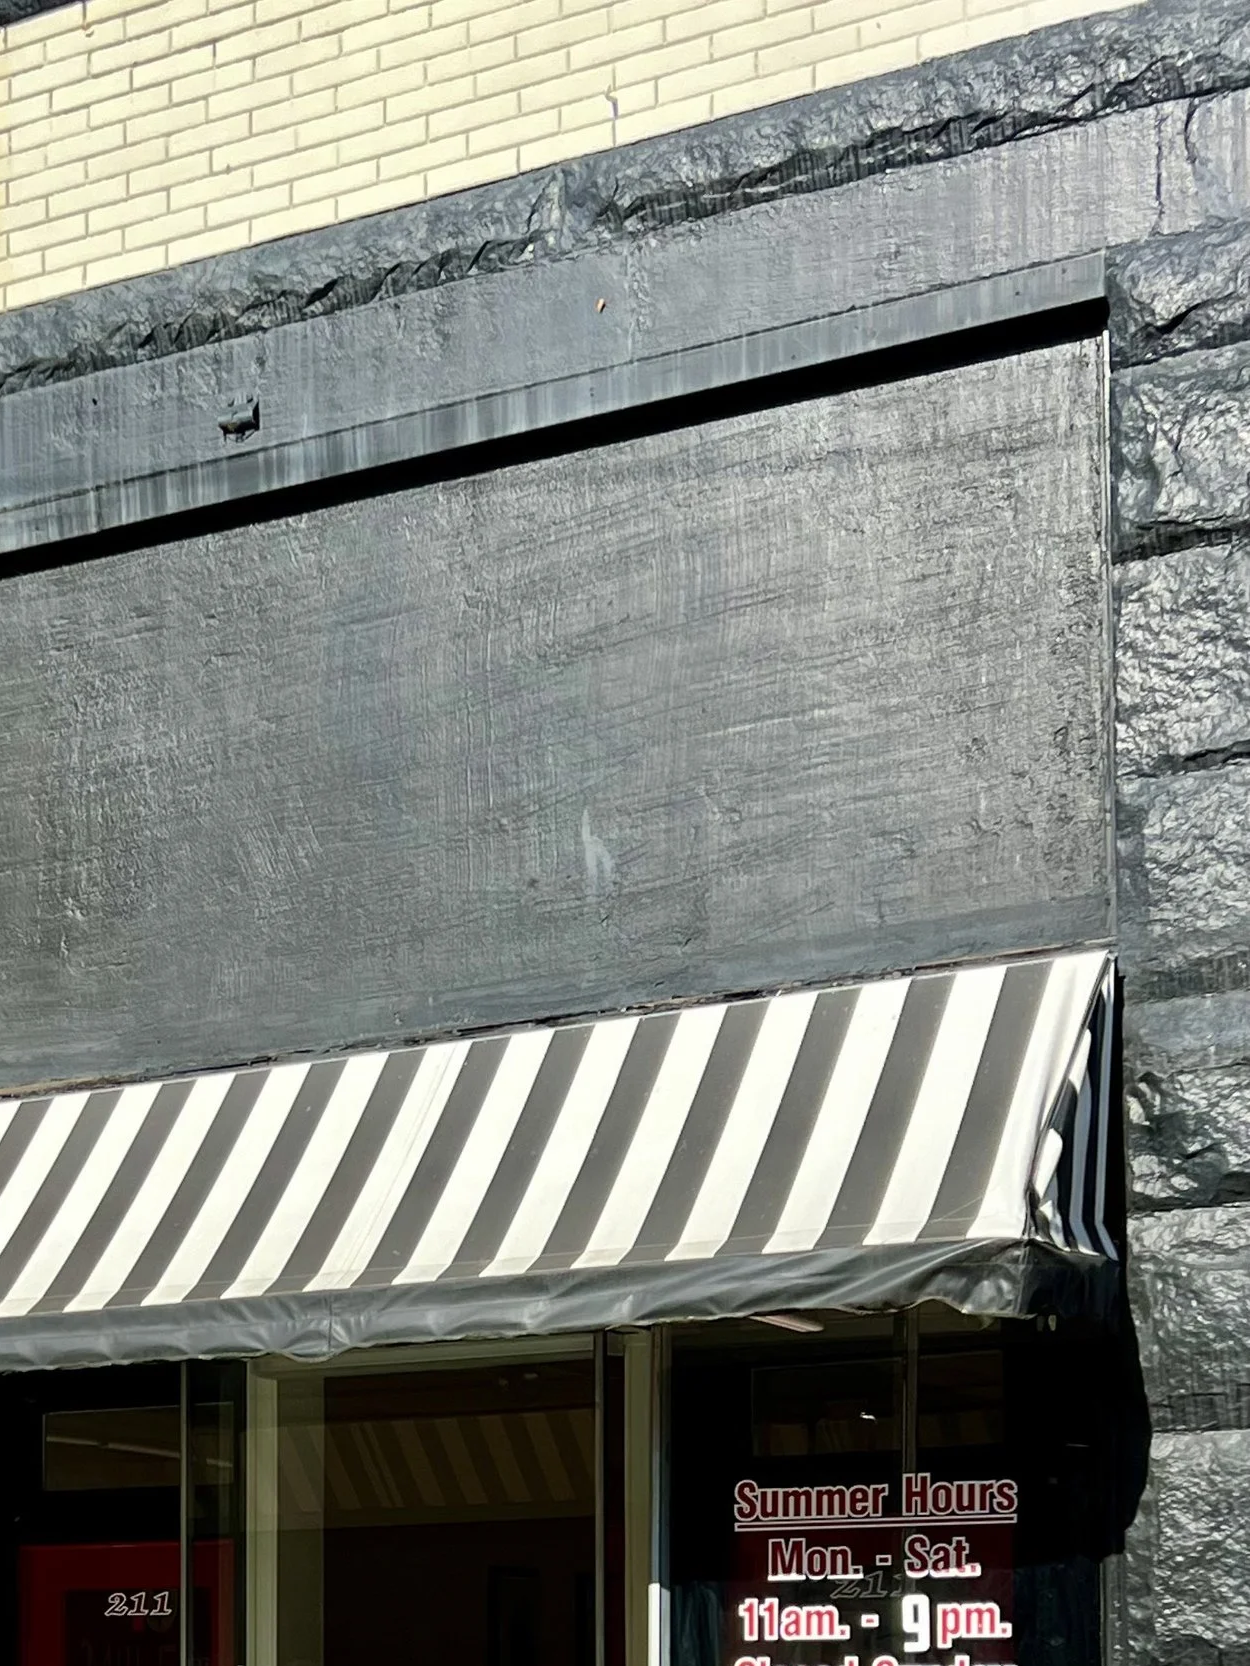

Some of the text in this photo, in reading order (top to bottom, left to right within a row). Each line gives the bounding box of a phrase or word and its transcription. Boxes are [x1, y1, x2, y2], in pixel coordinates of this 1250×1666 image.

[735, 1472, 1018, 1521] Summer Hours
[768, 1538, 864, 1581] Mon.
[904, 1534, 981, 1578] Sat.
[104, 1591, 173, 1617] 211
[738, 1597, 851, 1642] 11am.
